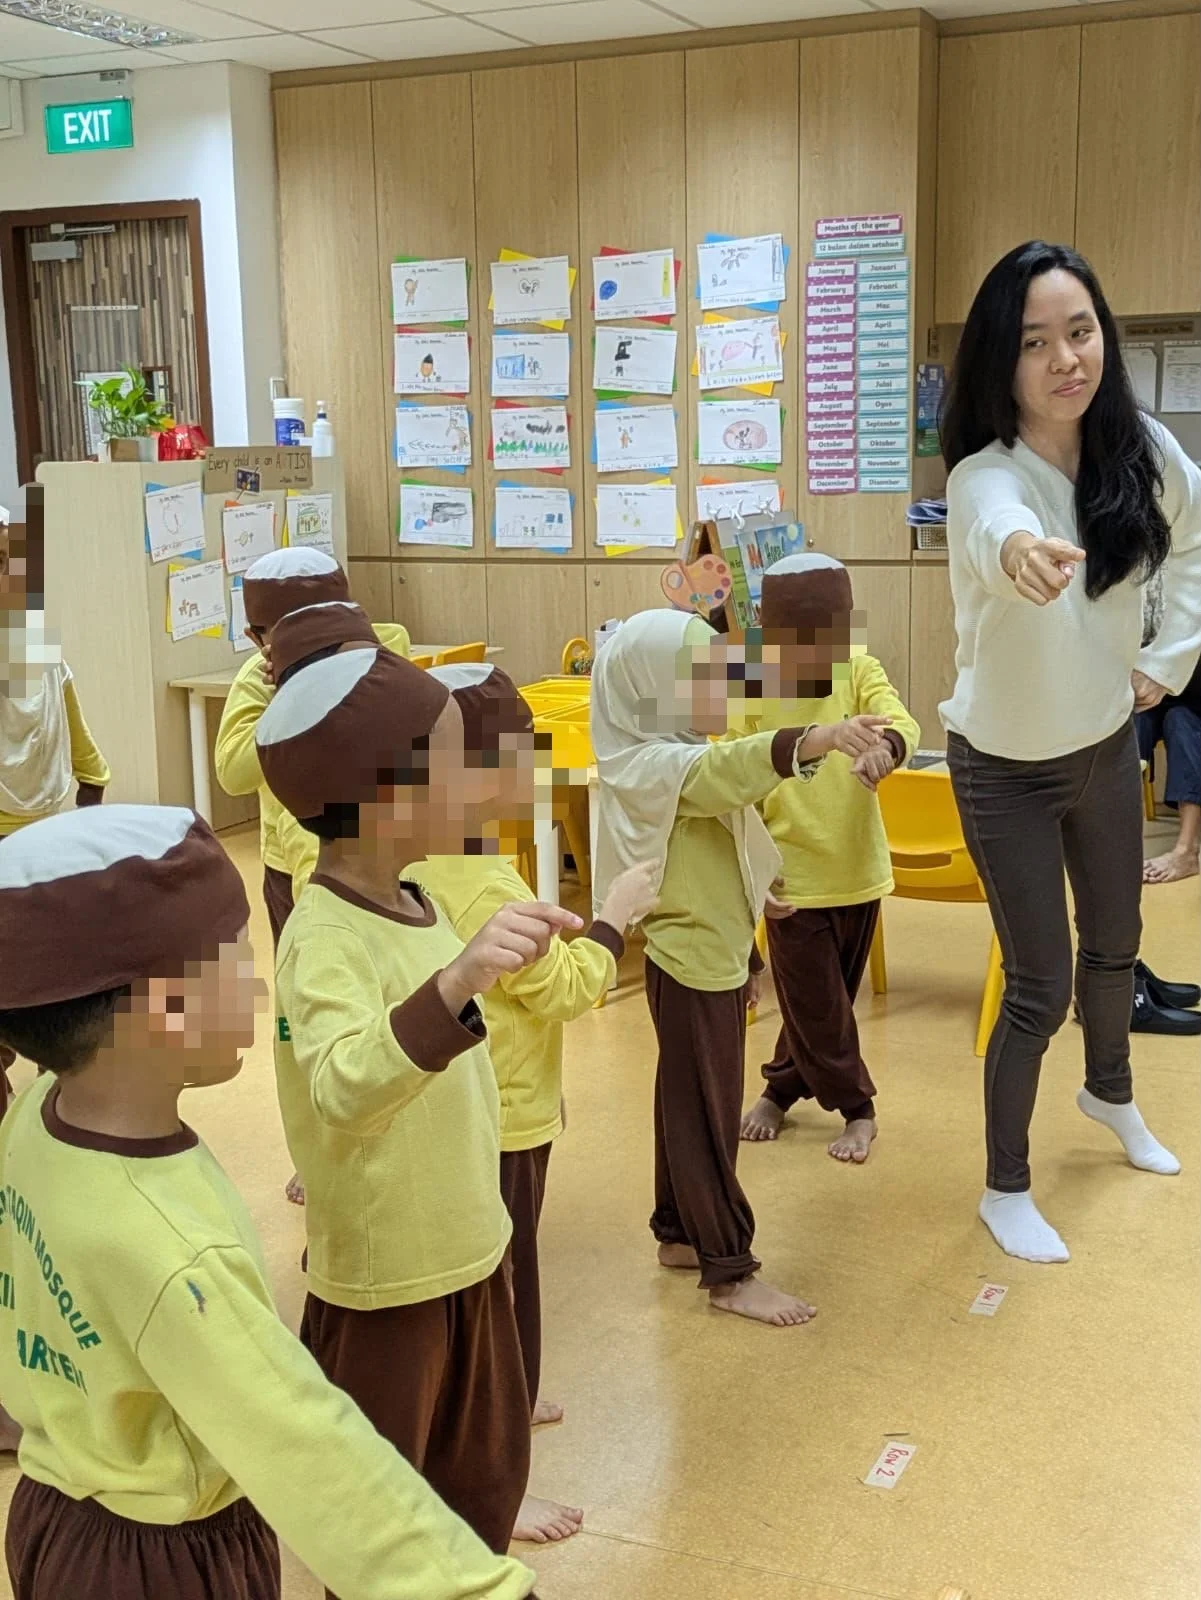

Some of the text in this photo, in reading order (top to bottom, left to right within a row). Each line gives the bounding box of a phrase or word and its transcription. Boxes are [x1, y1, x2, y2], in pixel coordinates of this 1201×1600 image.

[64, 109, 112, 144] EXIT
[824, 224, 849, 232] Months
[850, 222, 858, 231] of
[875, 222, 891, 230] year
[818, 267, 846, 275] January
[816, 286, 846, 294] February
[868, 282, 898, 290] Februari
[820, 305, 842, 313] March
[822, 324, 839, 332] April
[875, 320, 892, 329] April
[823, 344, 837, 352] May
[823, 383, 838, 391] July
[819, 402, 842, 410] August
[813, 421, 848, 429] September
[866, 420, 901, 428] September
[818, 440, 844, 448] October
[870, 439, 896, 447] Oktober
[208, 453, 228, 473] Every
[234, 453, 250, 467] child
[867, 459, 900, 467] November
[816, 479, 849, 487] December
[35, 1229, 102, 1350] MOSQUE
[875, 1467, 895, 1477] 2
